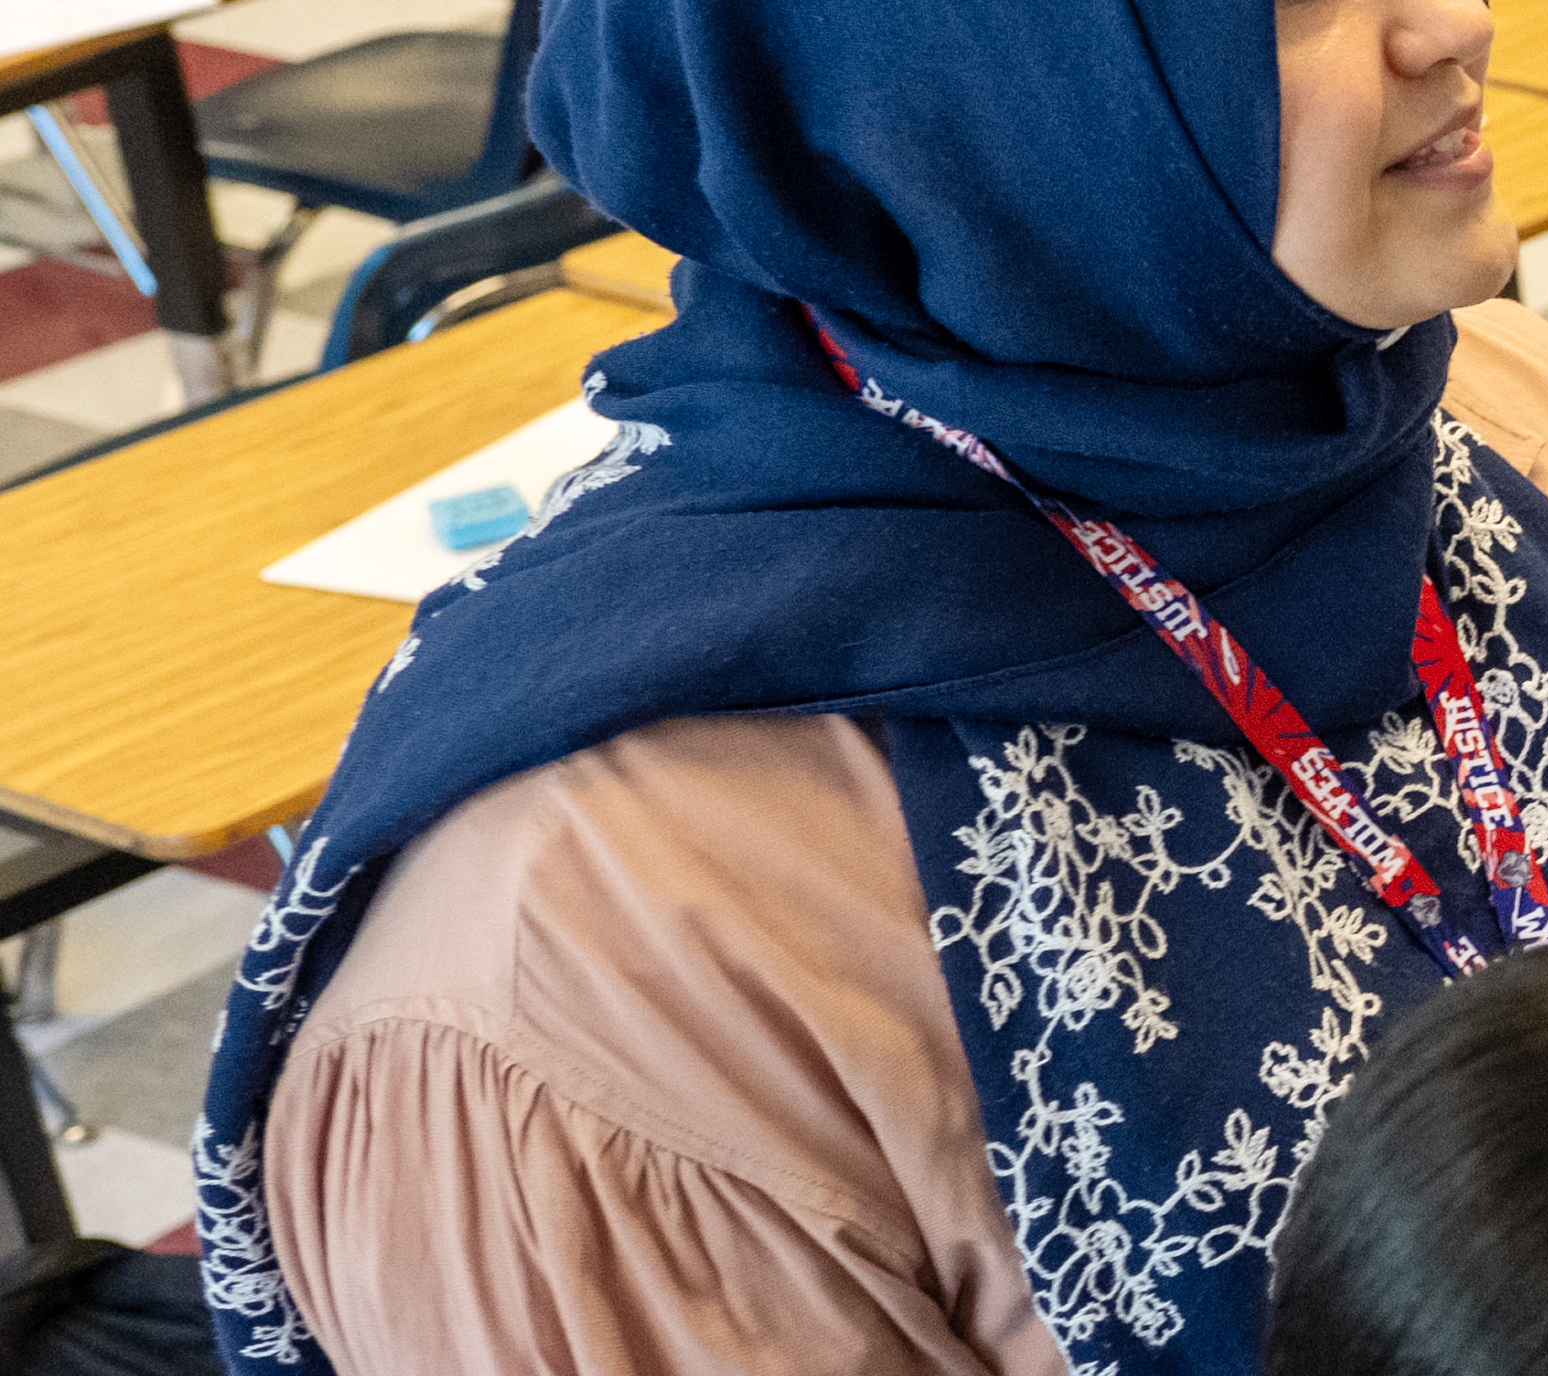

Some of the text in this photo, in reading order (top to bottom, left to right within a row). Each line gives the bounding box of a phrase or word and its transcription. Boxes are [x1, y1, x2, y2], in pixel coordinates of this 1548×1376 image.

[1072, 520, 1405, 884] WOLVES JUSTICE
[1439, 691, 1515, 830] JUSTICE
